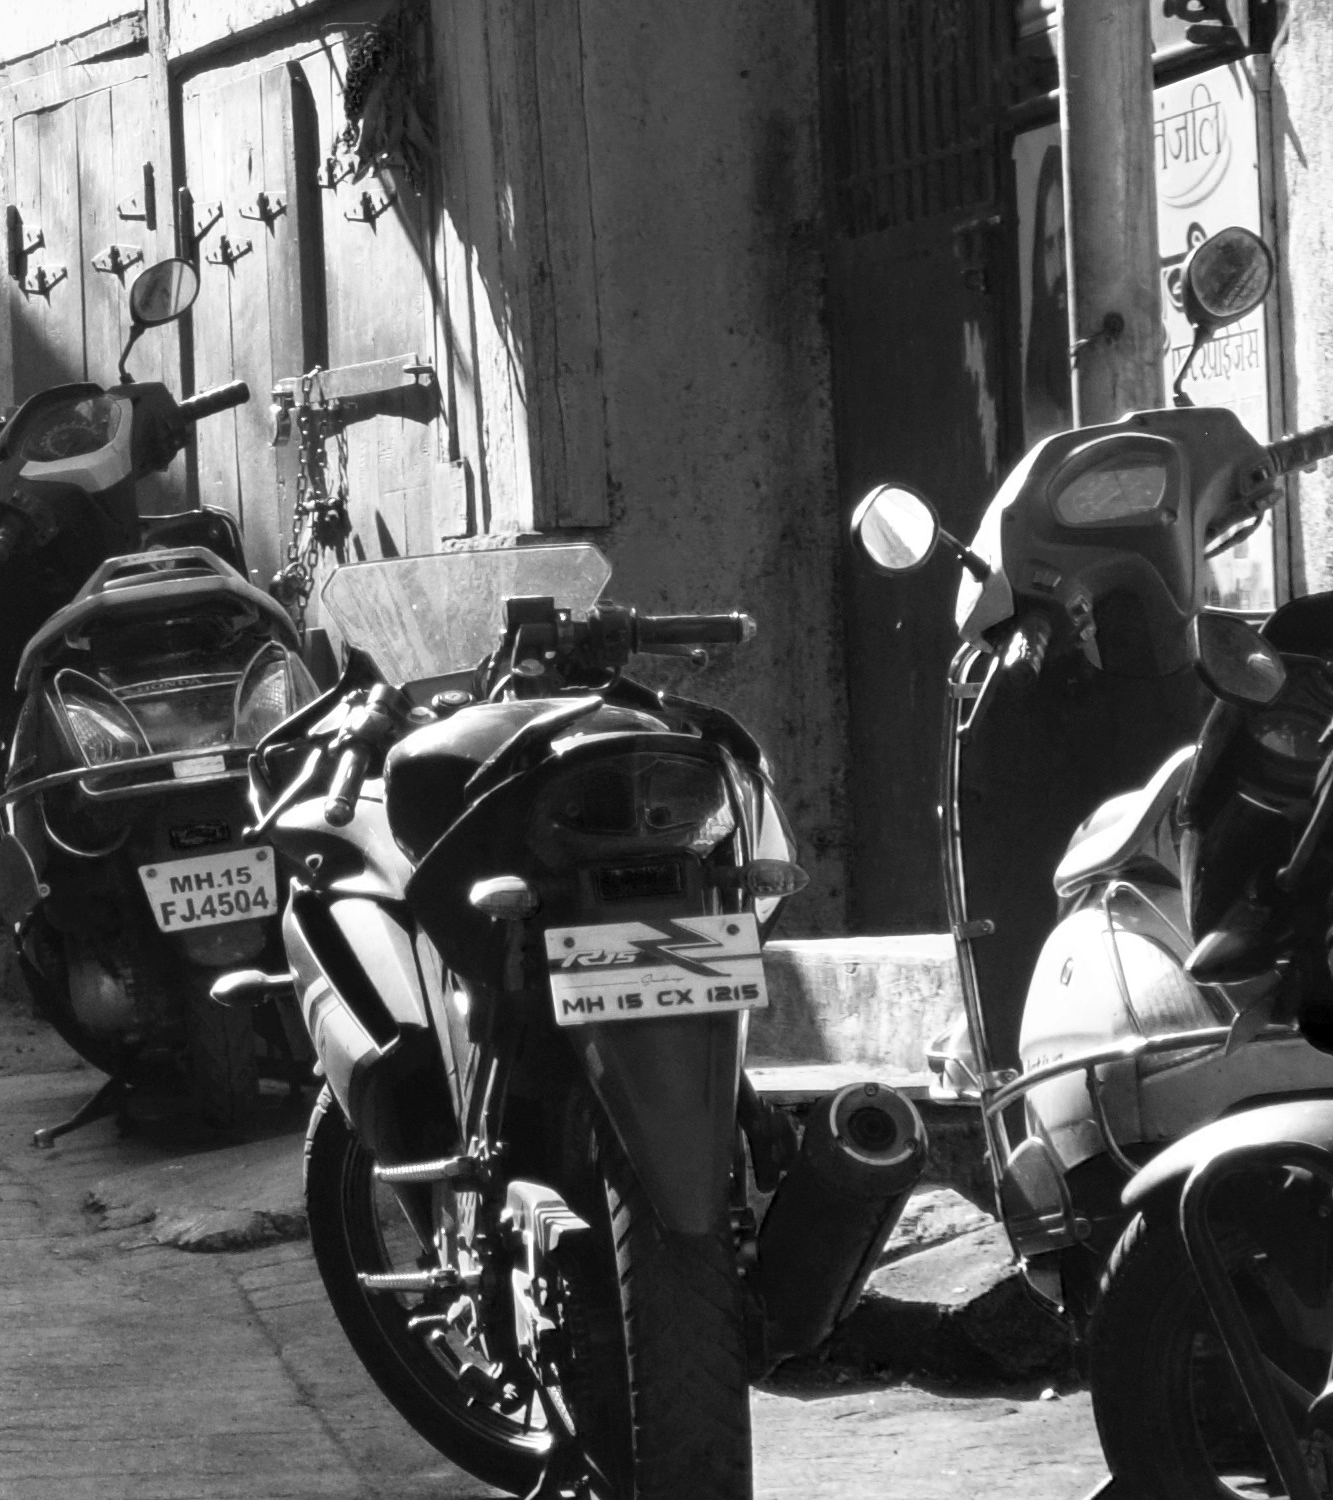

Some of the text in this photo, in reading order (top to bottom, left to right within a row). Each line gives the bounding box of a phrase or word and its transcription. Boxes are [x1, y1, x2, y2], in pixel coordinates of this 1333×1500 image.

[169, 866, 253, 894] MH.15
[159, 890, 270, 933] FJ.4504
[562, 983, 760, 1016] MH 15 CX 1215
